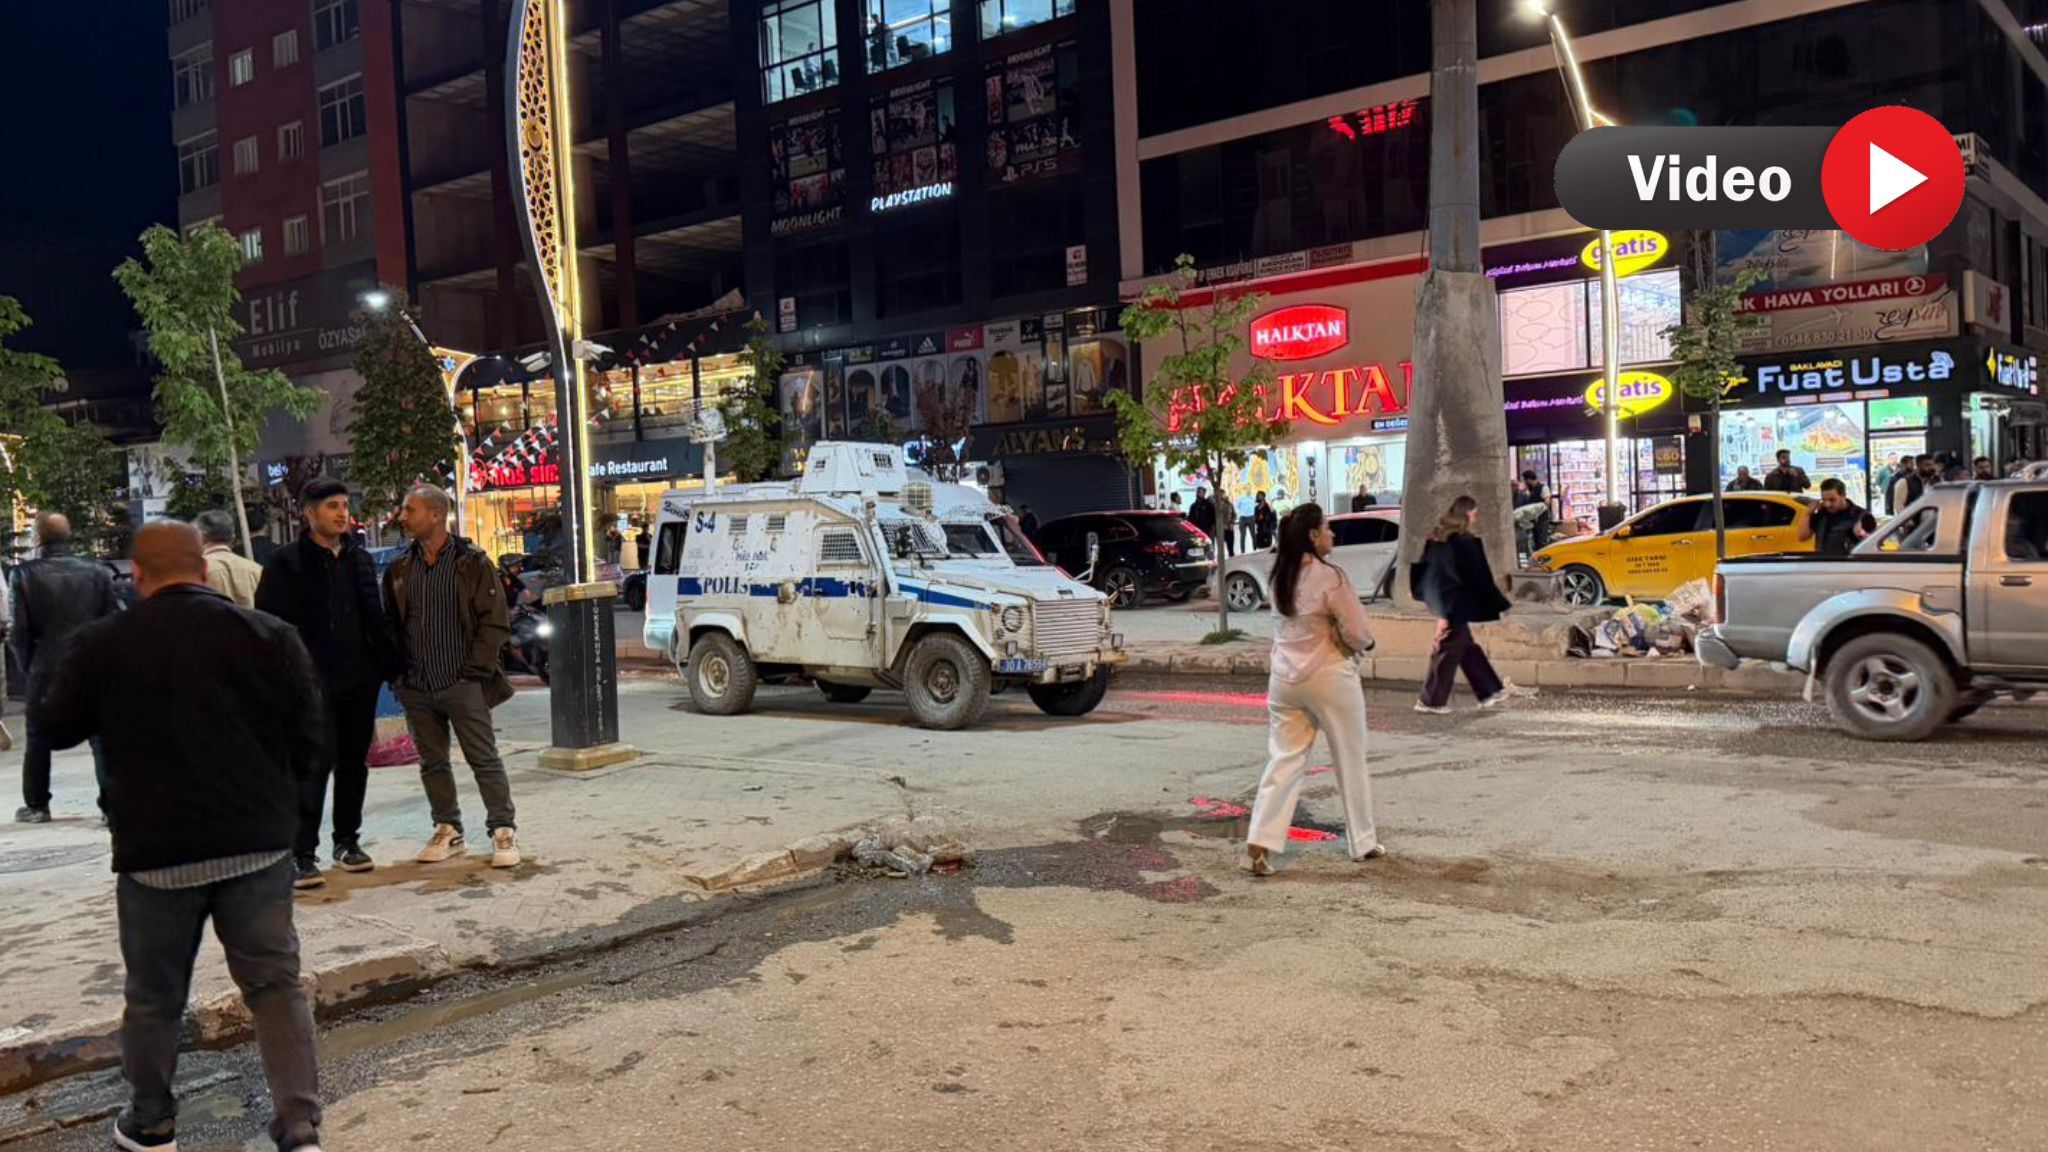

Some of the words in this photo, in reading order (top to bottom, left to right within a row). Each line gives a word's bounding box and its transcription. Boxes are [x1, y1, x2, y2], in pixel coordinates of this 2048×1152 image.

[870, 181, 952, 213] PLAYSTATION
[770, 206, 842, 234] MOONLIGHT
[1592, 233, 1657, 264] gatis
[1764, 290, 1814, 309] HAVA
[1819, 282, 1899, 303] YOLLARI
[250, 290, 299, 335] Elif
[1257, 319, 1342, 344] HALKTAN
[1757, 365, 1844, 393] Fuat
[1851, 356, 1951, 386] Usta
[1790, 359, 1843, 372] BAKLAVACI
[1596, 376, 1661, 407] gatis
[589, 464, 605, 477] afe
[607, 457, 668, 476] Restaurant
